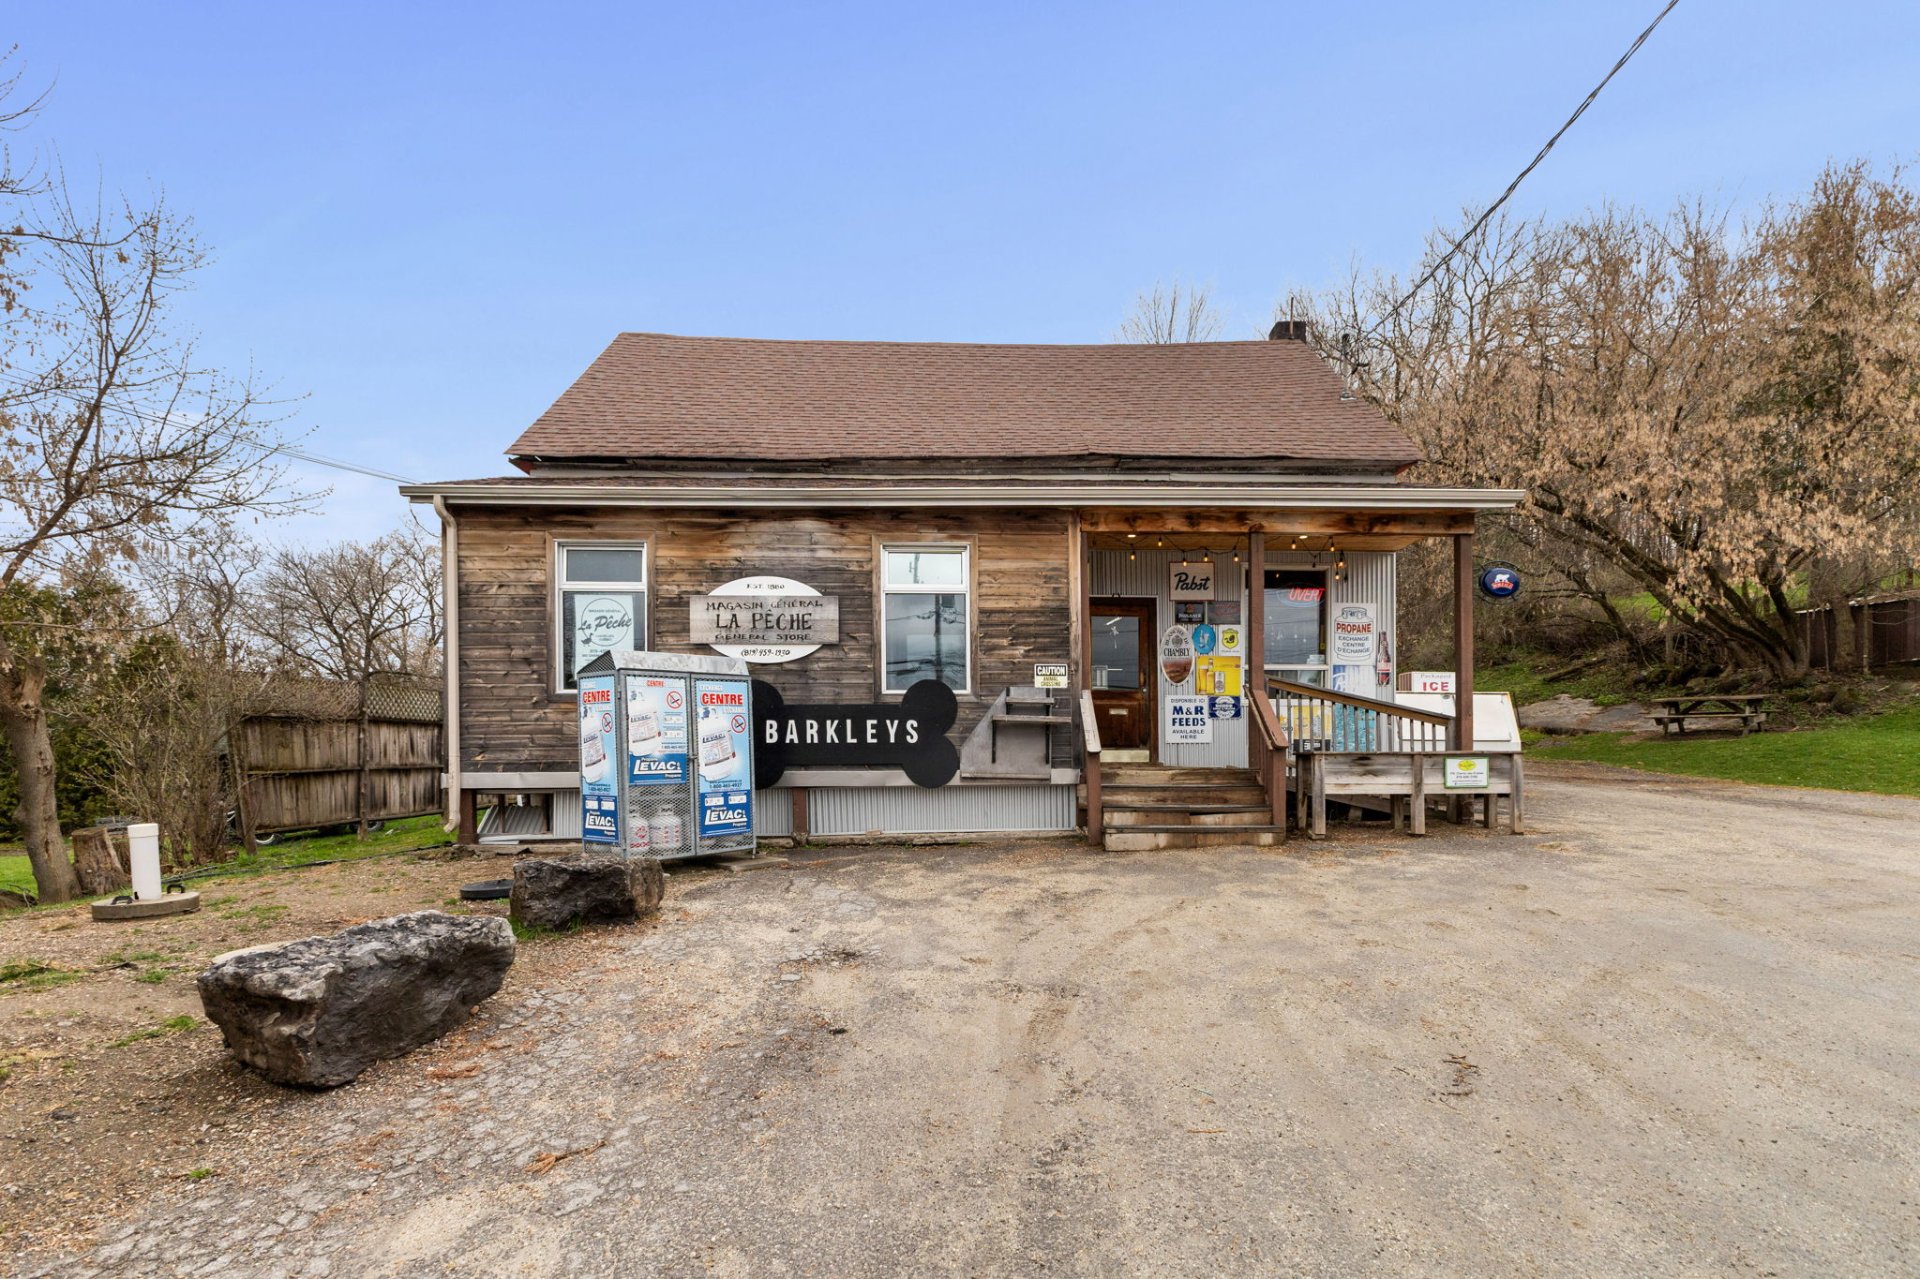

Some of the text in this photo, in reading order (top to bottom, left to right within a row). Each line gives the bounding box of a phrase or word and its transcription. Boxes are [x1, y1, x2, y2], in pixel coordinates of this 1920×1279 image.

[1174, 572, 1210, 590] Pabst
[706, 599, 823, 611] MAGASIN GÉNÉRAL
[594, 612, 632, 632] Pêche
[715, 609, 812, 631] LA PÊCHE
[1336, 622, 1372, 634] PROPANE
[715, 633, 812, 641] GENERAL STORE
[1163, 647, 1191, 657] CHAMBLY
[1036, 665, 1066, 676] CAUTION
[1423, 681, 1450, 692] ICE
[582, 689, 611, 704] CENTRE
[701, 692, 743, 706] CENTRE
[1171, 717, 1206, 727] FEEDS
[765, 719, 920, 744] BARKLEYS
[633, 760, 683, 775] LEVAC
[585, 812, 617, 831] LEVAC
[704, 809, 748, 826] LEVAC
